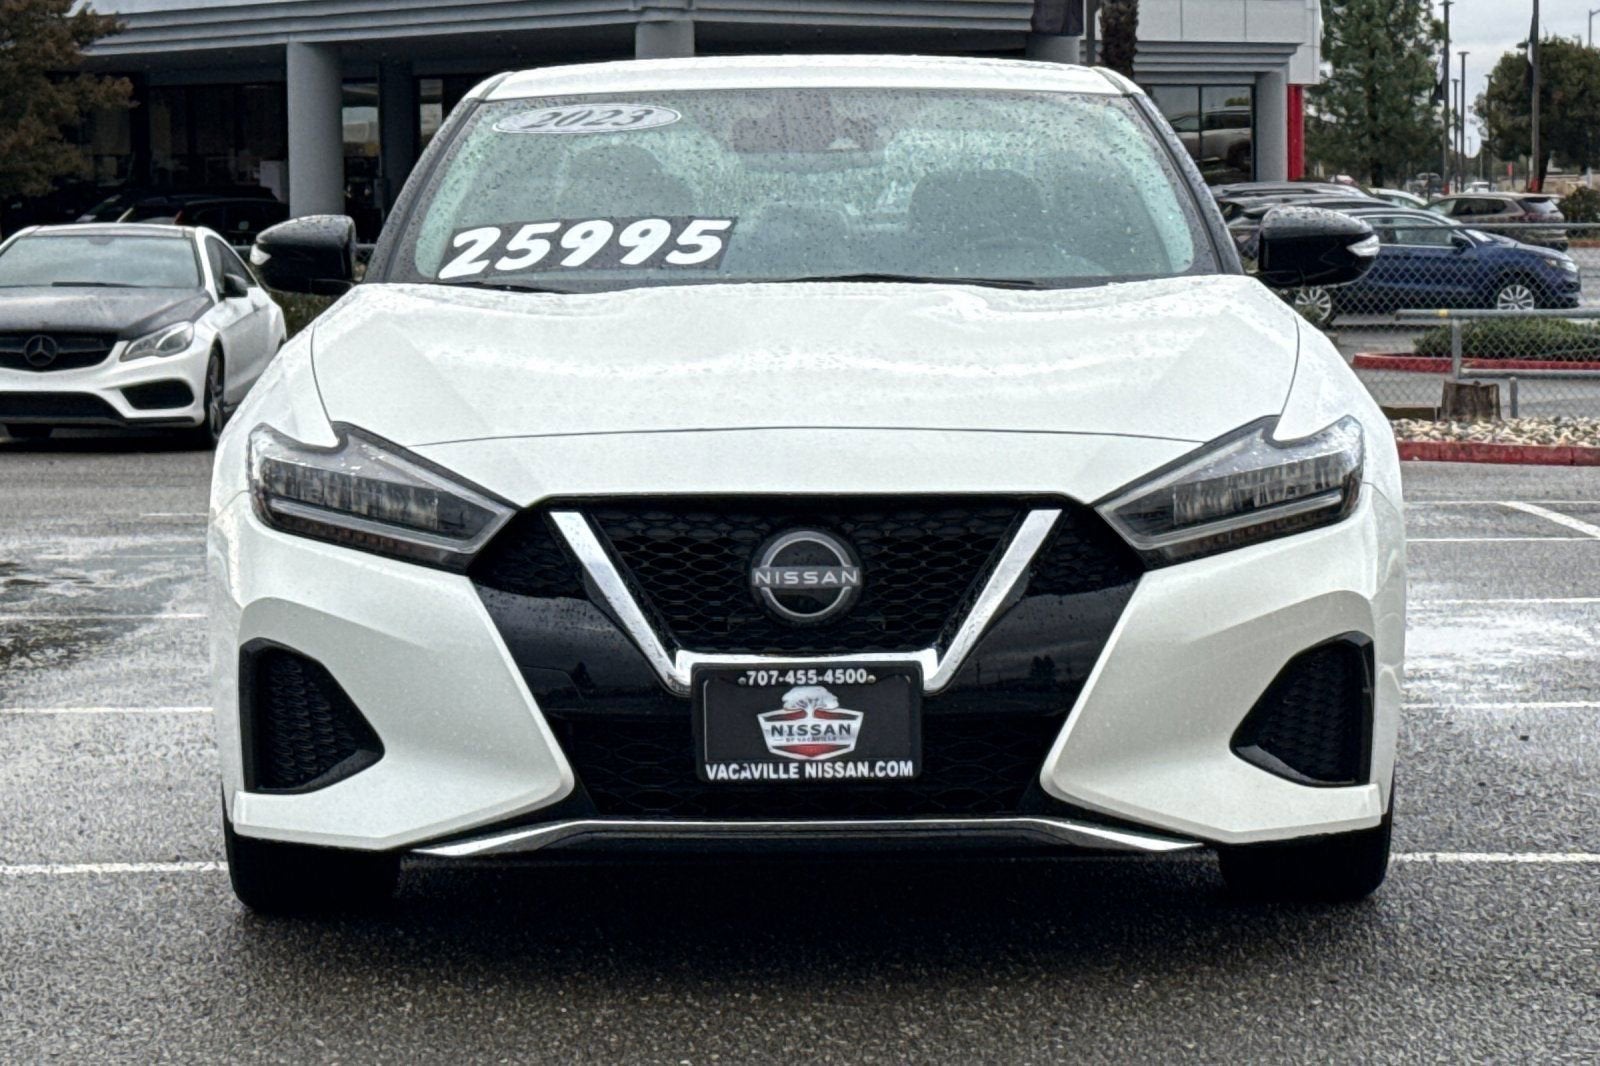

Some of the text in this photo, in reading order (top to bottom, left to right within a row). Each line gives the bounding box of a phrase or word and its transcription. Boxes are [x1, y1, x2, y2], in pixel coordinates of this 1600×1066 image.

[521, 109, 654, 129] 2023
[438, 218, 732, 280] 25995
[755, 570, 857, 585] NISSAN
[746, 668, 867, 686] 707-455-4500
[771, 723, 850, 737] NISSAN
[705, 760, 913, 780] VACAVILLE NISSAN.COM
